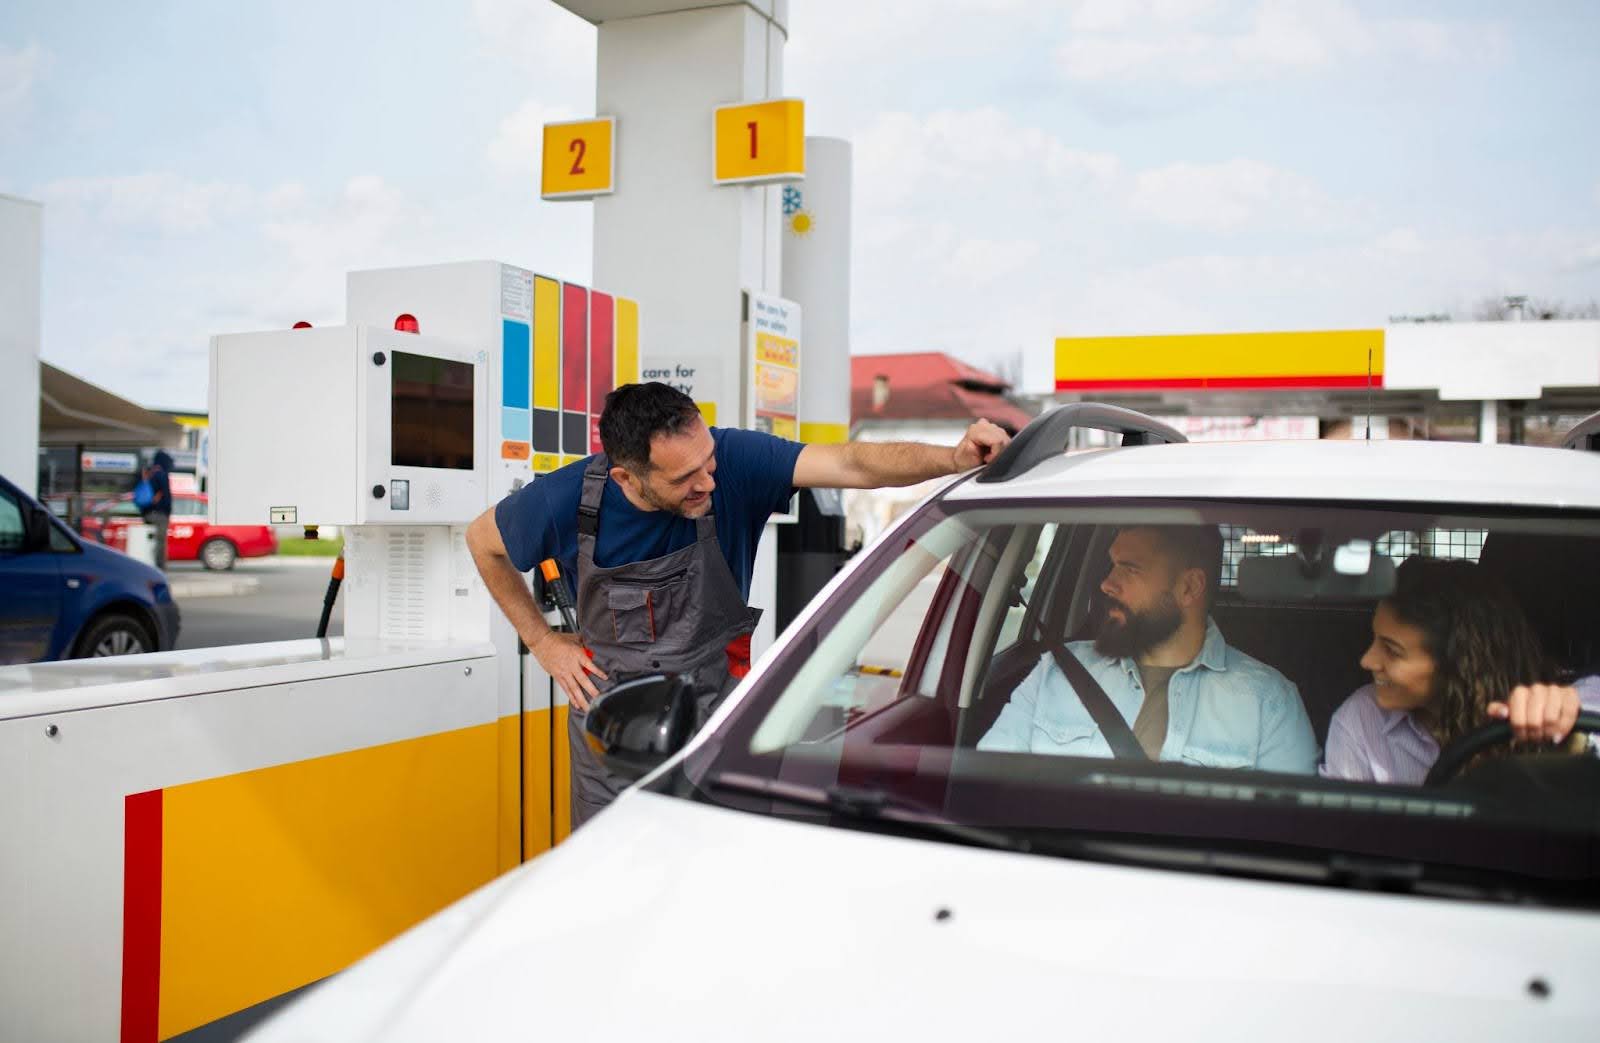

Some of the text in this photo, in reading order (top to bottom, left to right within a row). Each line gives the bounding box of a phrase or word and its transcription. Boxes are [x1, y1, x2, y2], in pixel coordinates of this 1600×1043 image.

[569, 138, 586, 175] 2
[747, 121, 758, 159] 1
[642, 364, 696, 378] care for
